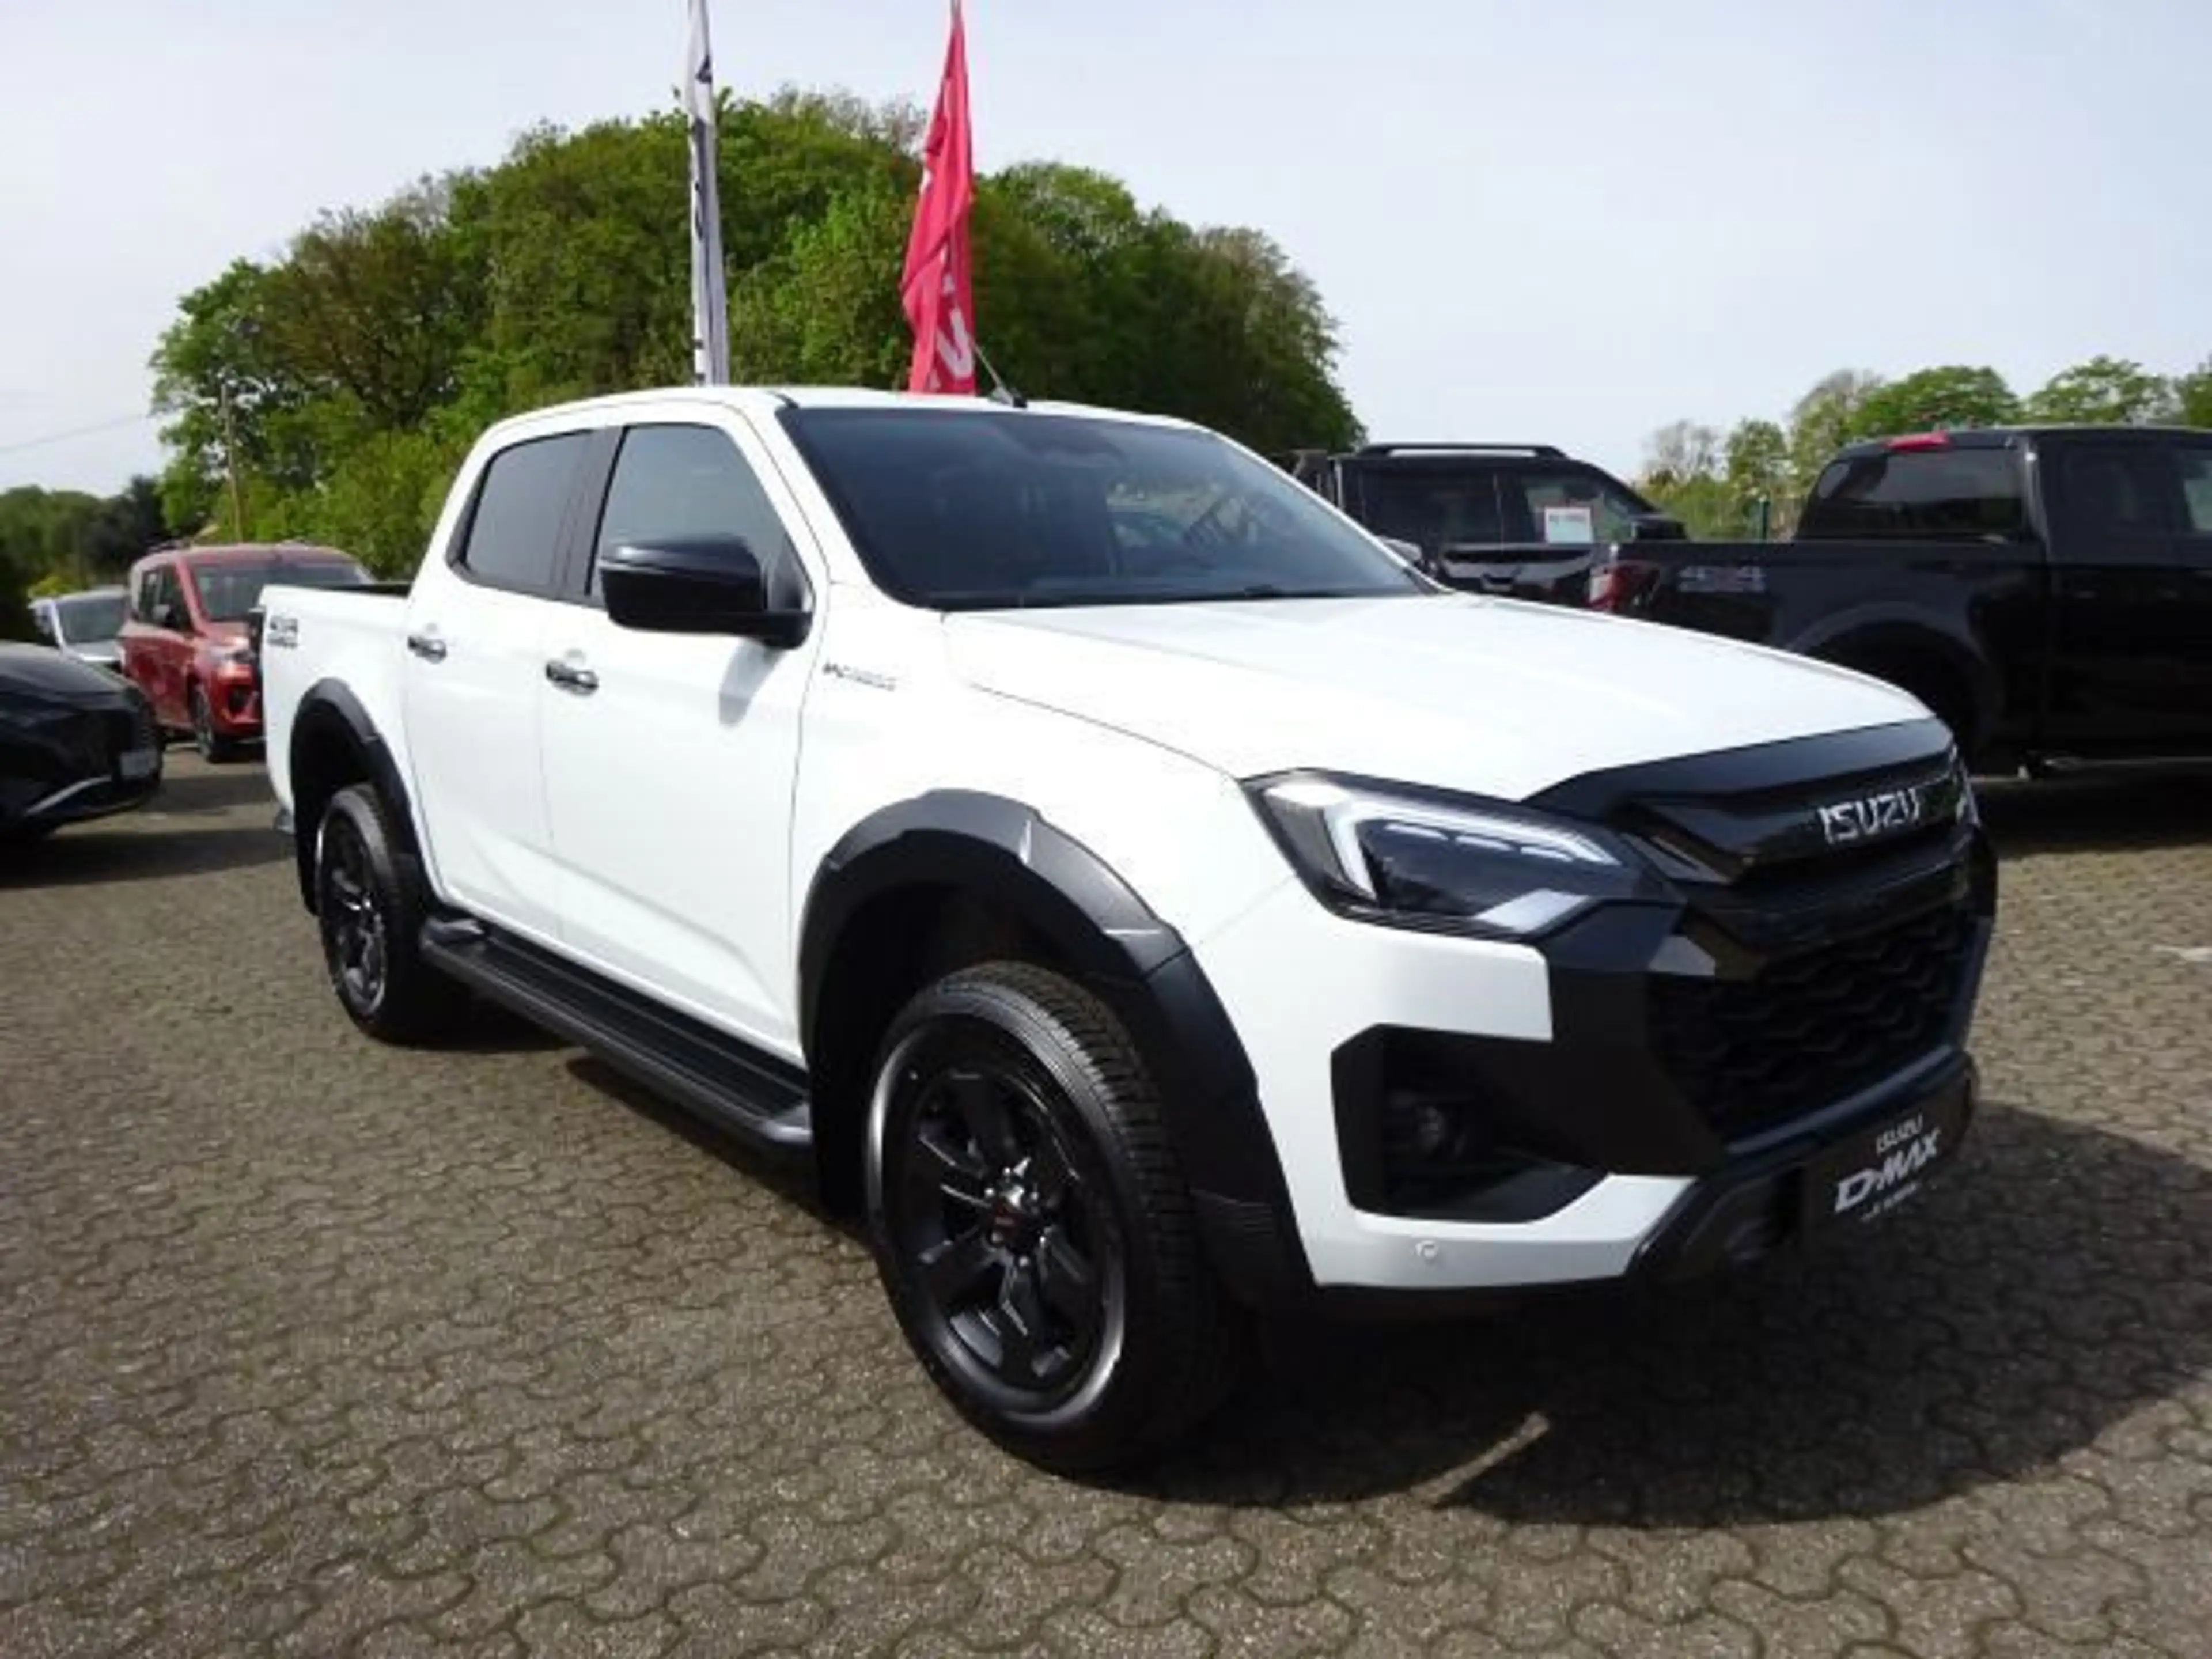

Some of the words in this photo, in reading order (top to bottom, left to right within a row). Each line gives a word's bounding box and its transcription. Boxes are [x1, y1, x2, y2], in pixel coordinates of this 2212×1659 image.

[1818, 787, 1921, 844] ISUZU
[1876, 1113, 1923, 1156] ISUZU
[1835, 1127, 1941, 1212] D-MAX
